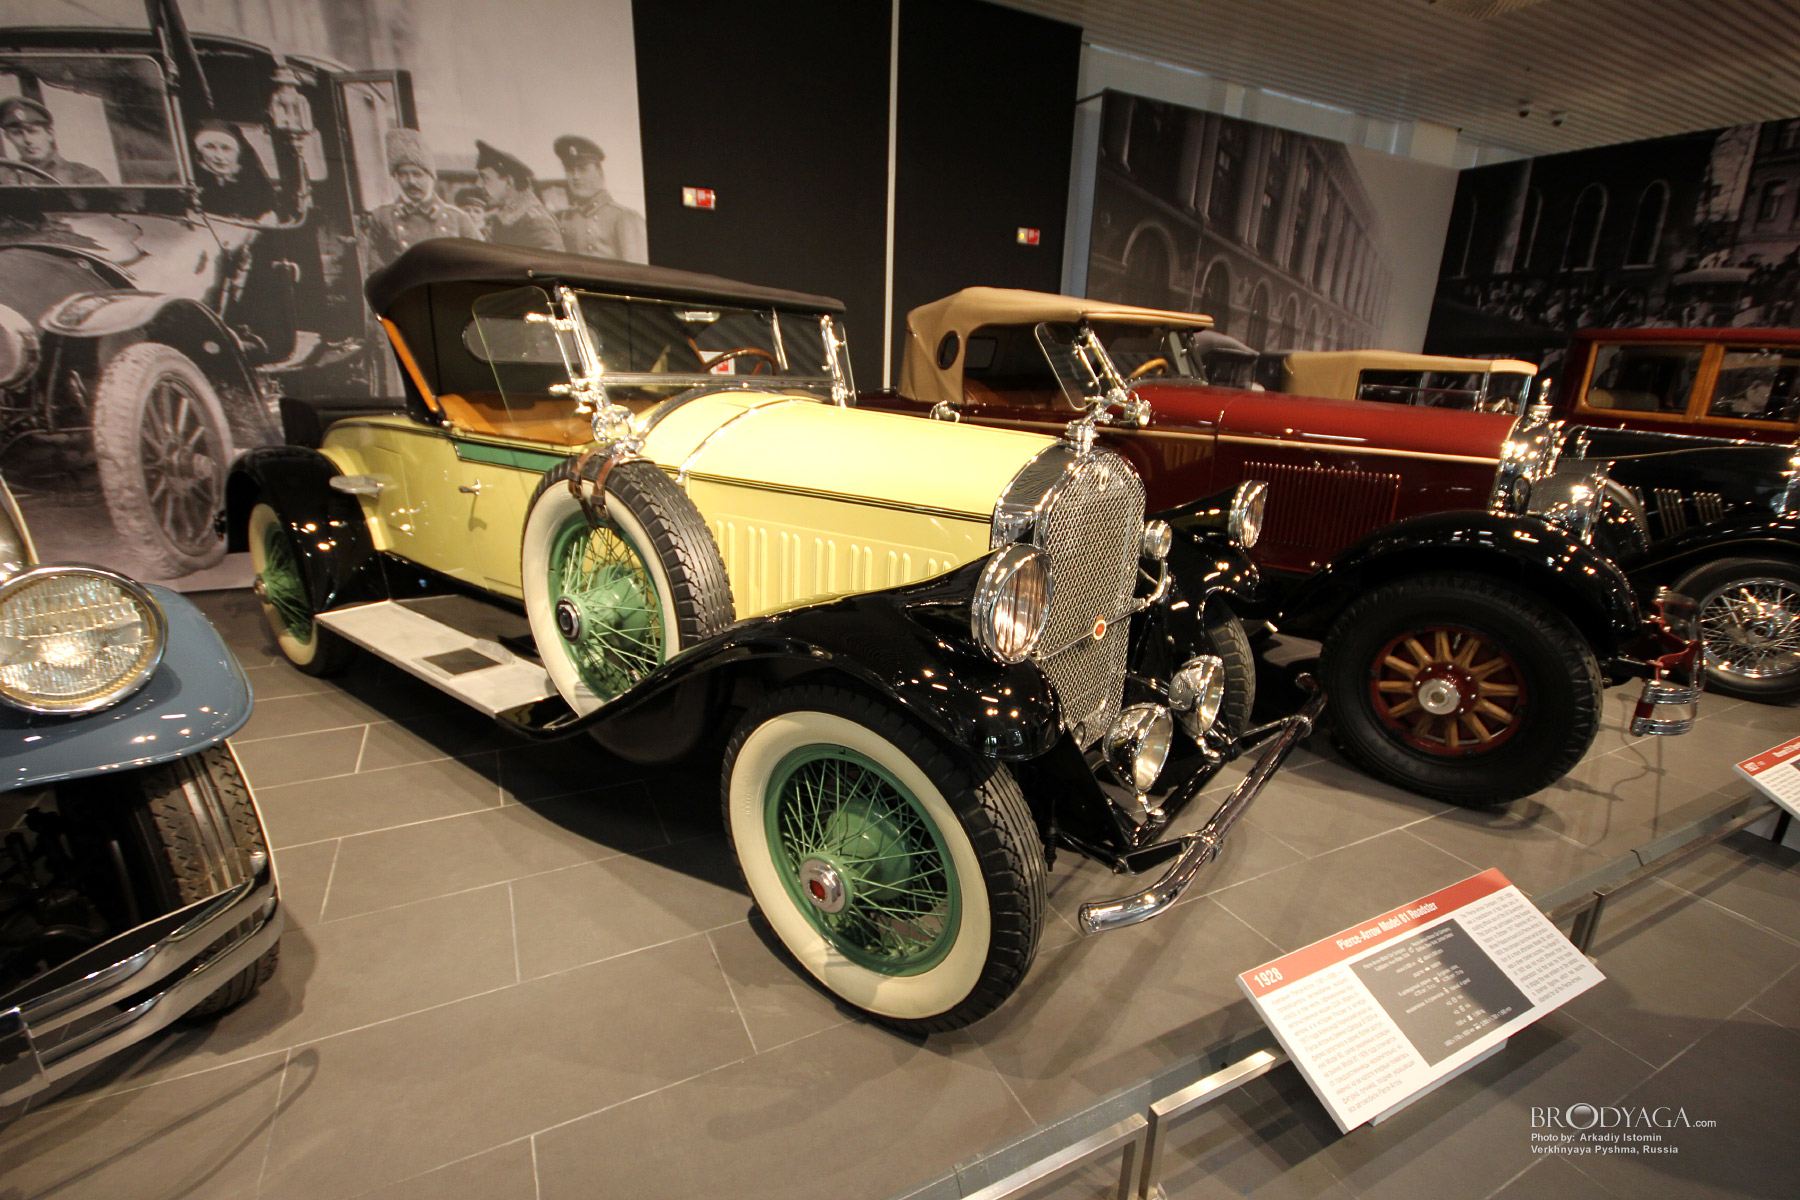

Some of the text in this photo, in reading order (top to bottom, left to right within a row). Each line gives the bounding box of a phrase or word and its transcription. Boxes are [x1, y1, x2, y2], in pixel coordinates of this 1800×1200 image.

[1336, 902, 1439, 951] Pierce-Arrow Model 81 Roadster
[1254, 967, 1284, 988] 1928
